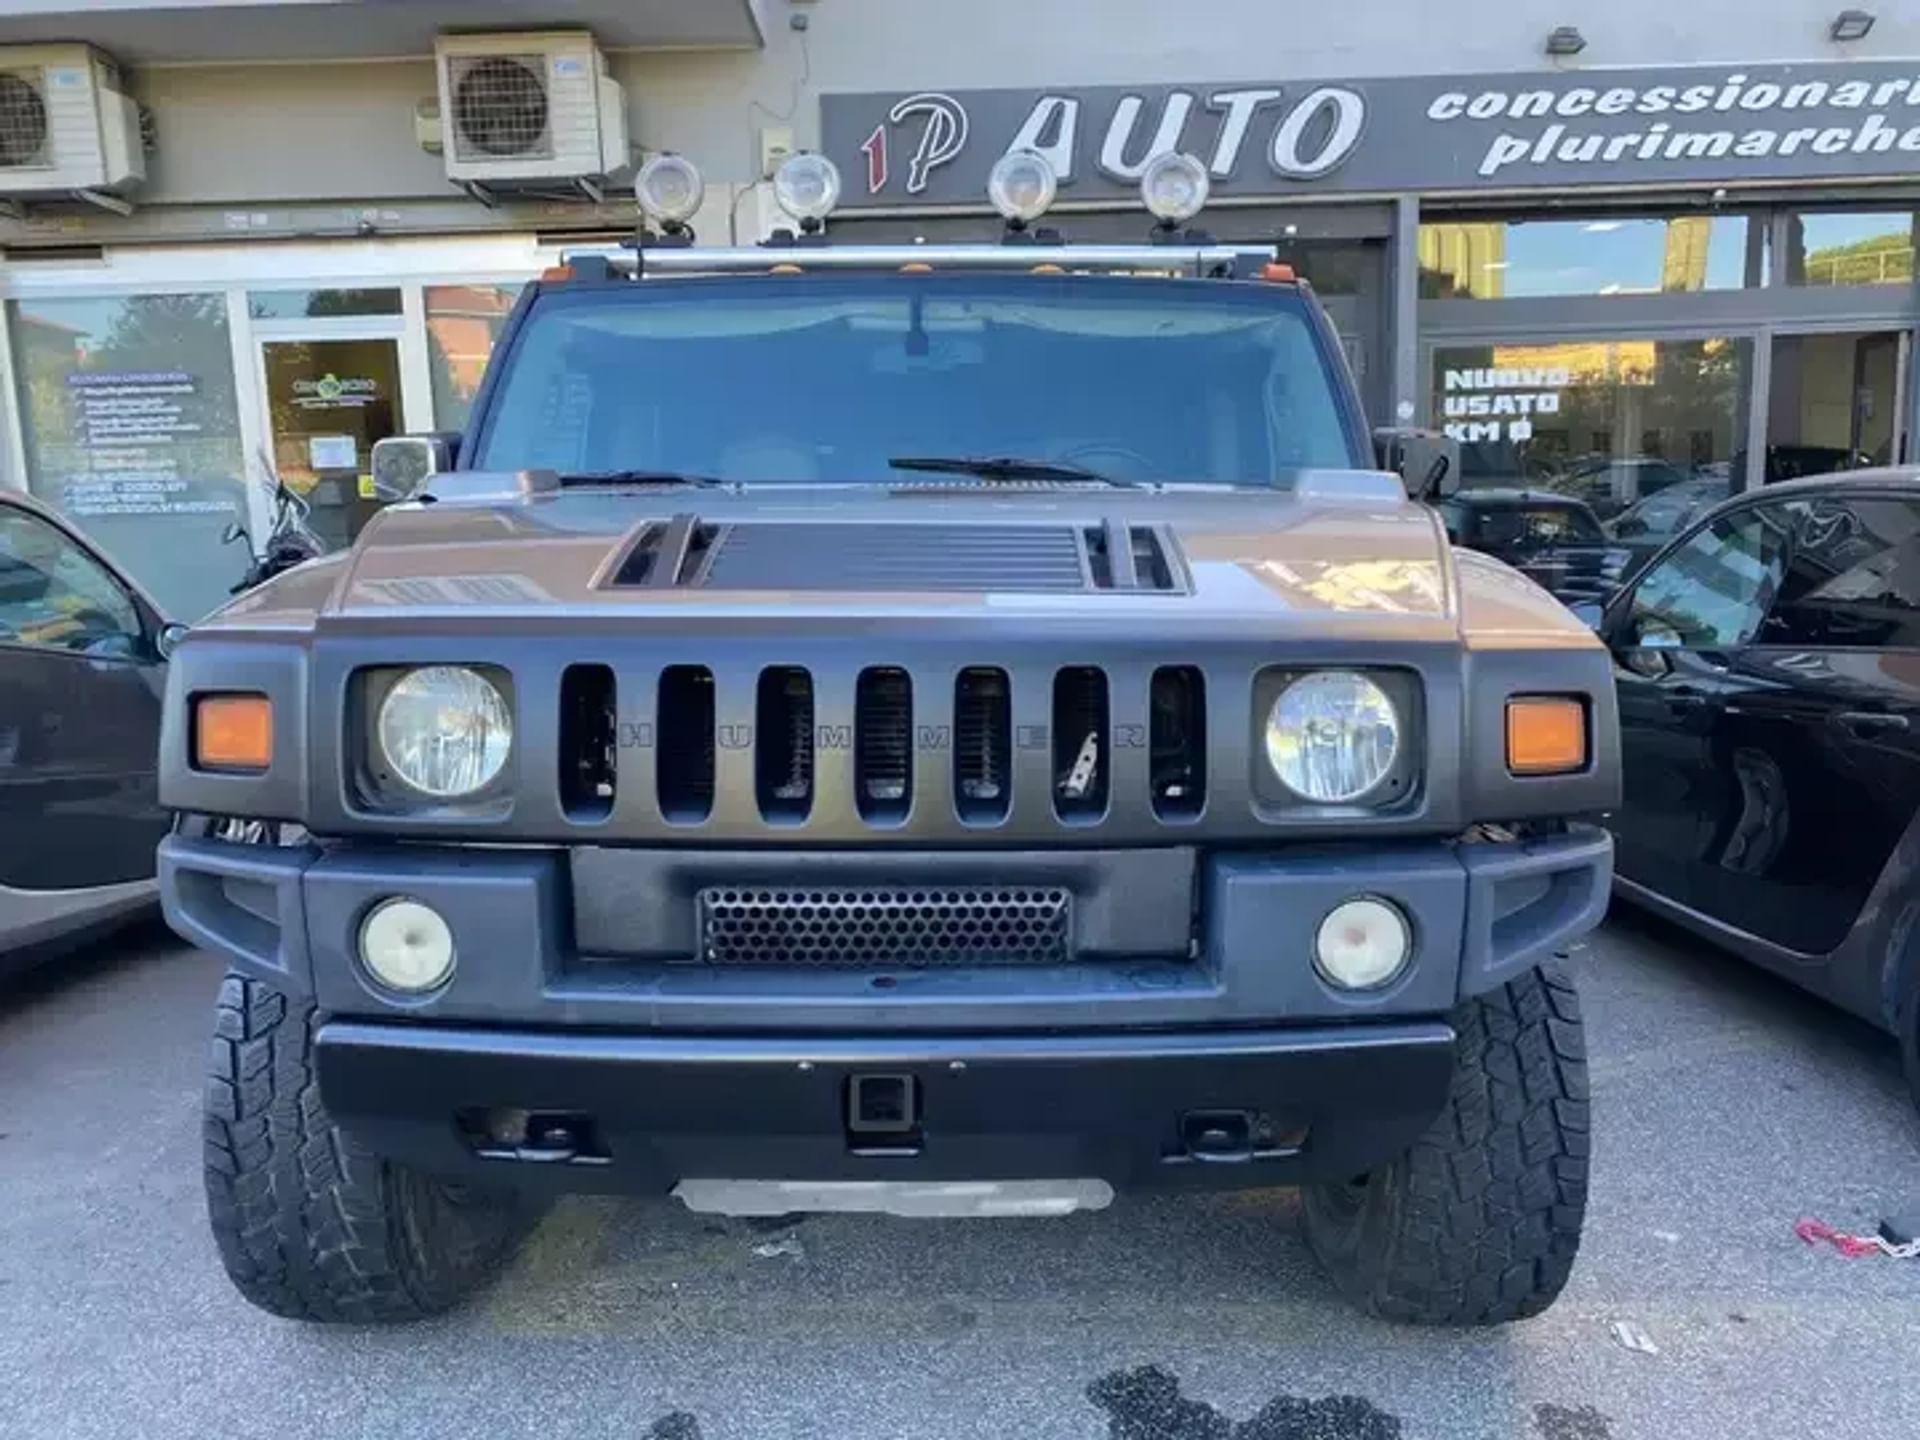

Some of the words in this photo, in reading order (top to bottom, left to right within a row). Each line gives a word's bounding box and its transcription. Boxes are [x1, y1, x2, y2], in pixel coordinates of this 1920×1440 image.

[1003, 87, 1367, 180] AUTO
[1478, 114, 1920, 176] plurimarche
[1445, 368, 1569, 390] NUOVO
[1445, 393, 1559, 416] USATO
[1445, 421, 1500, 443] KM
